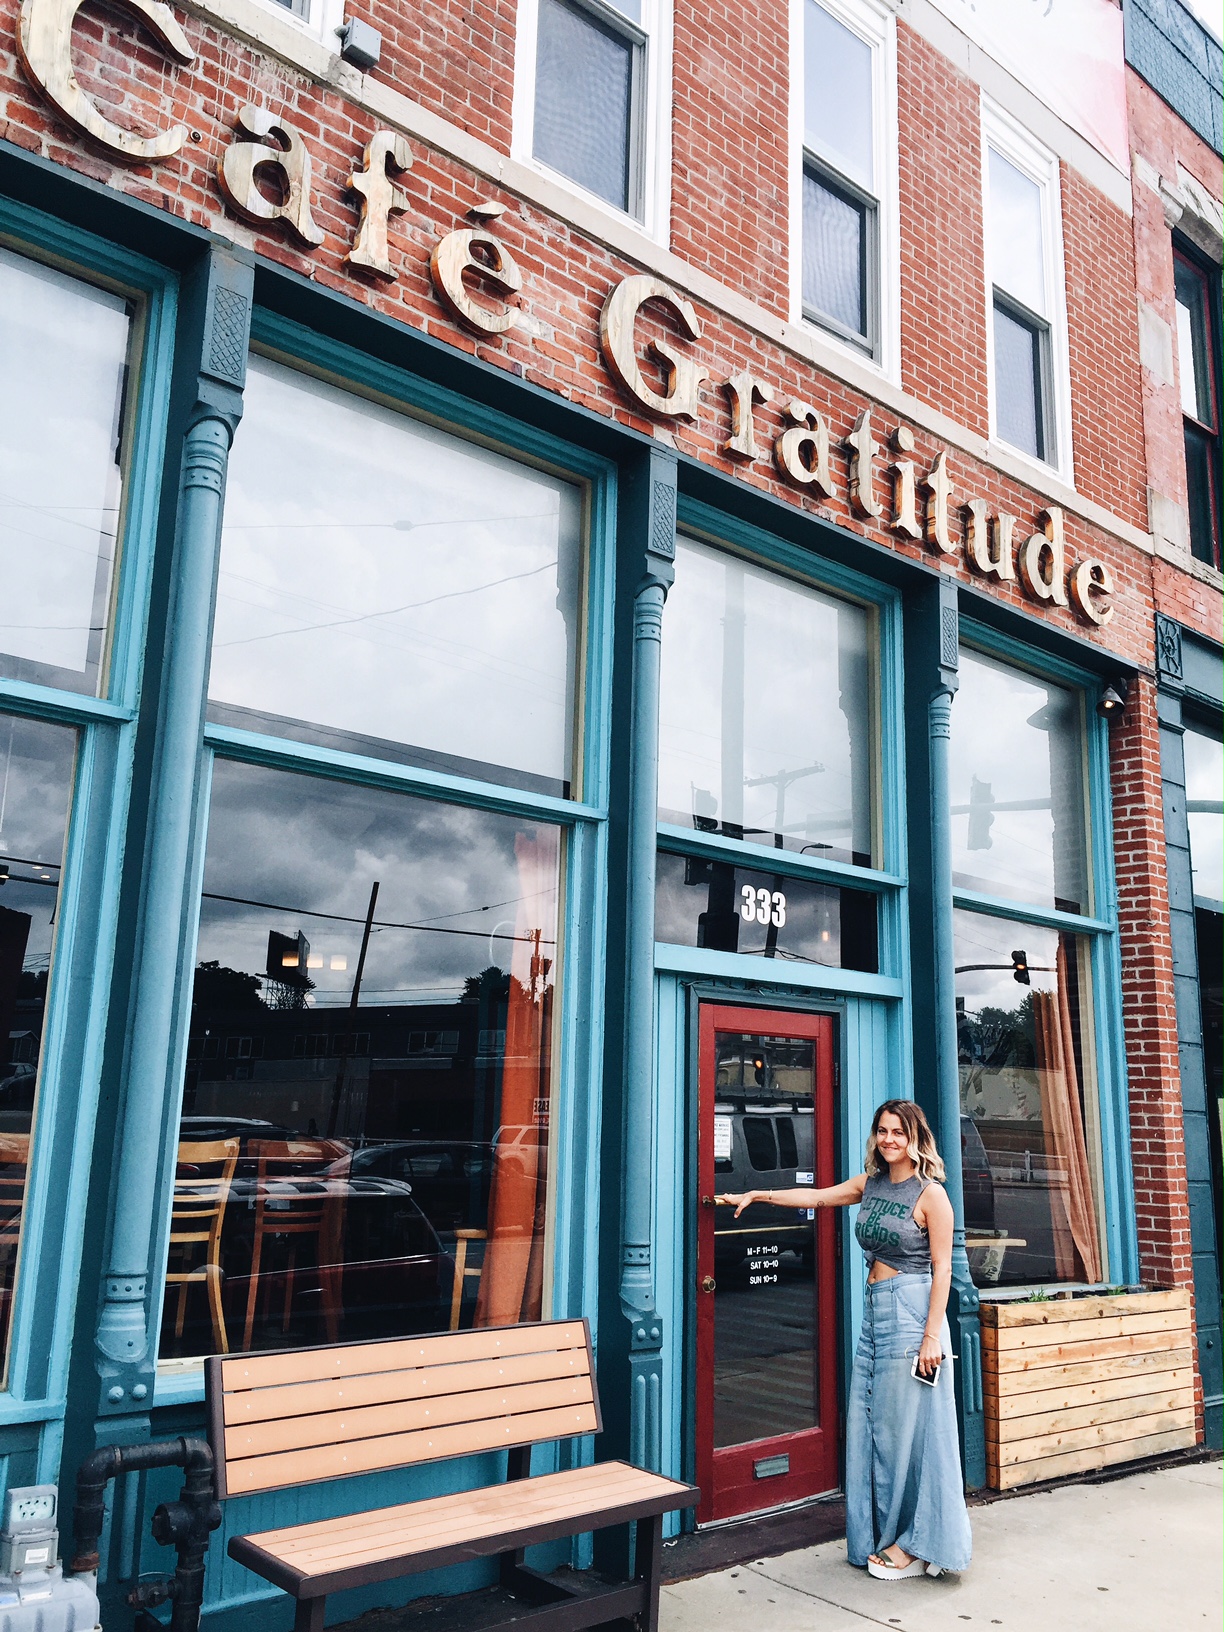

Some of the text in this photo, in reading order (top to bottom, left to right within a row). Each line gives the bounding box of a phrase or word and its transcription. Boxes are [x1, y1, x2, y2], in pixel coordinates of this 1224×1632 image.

[16, 0, 1114, 626] Café Gratitude
[741, 884, 786, 928] 333
[865, 1210, 886, 1227] BE
[762, 1245, 778, 1254] 11-10
[750, 1259, 779, 1270] SAT 10-10
[749, 1274, 778, 1285] SUN 10-9
